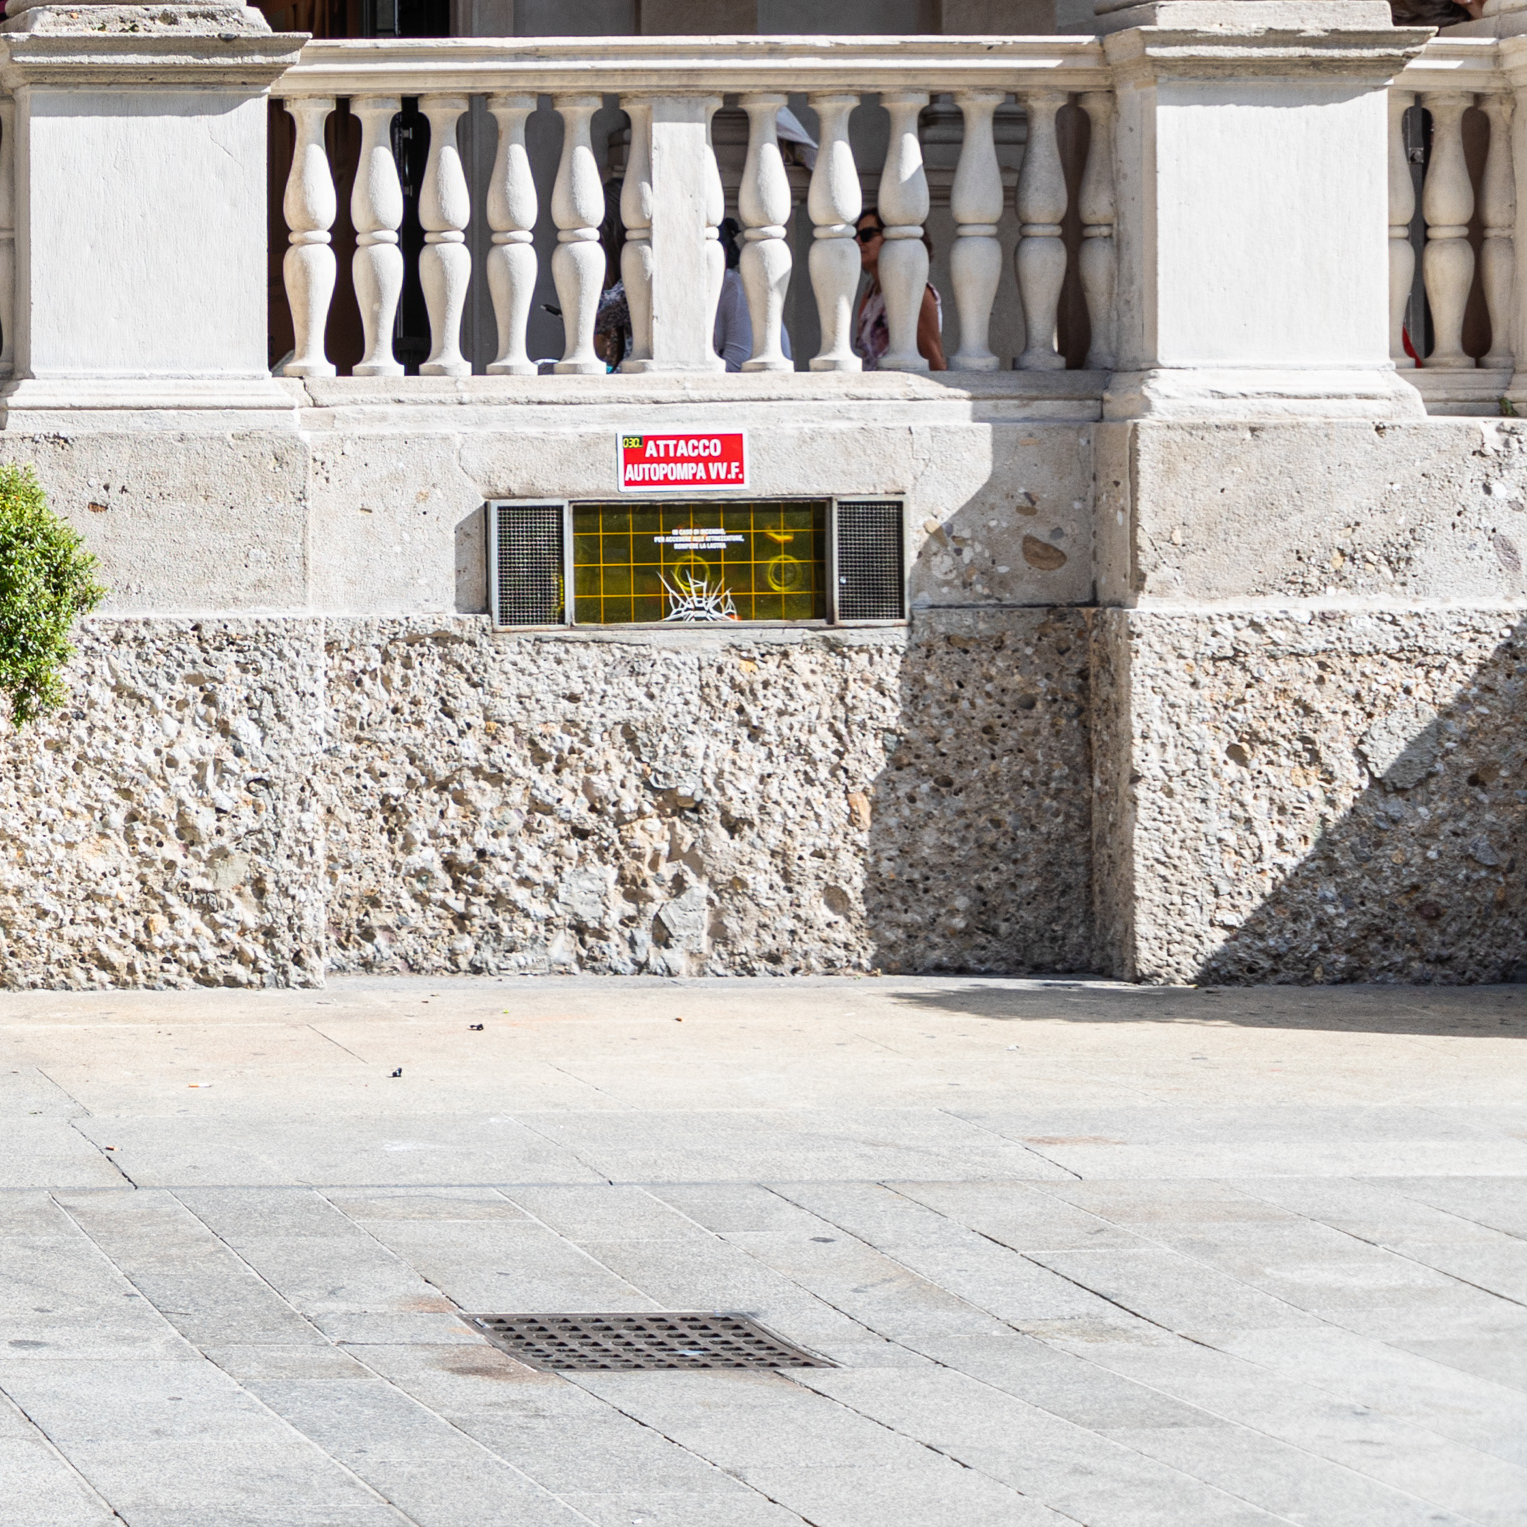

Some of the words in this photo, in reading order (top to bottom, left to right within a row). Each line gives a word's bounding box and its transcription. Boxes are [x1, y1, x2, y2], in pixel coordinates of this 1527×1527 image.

[645, 439, 722, 458] ATTACCO
[625, 462, 706, 481] AUTOPOMPA
[708, 461, 744, 480] VV.F.
